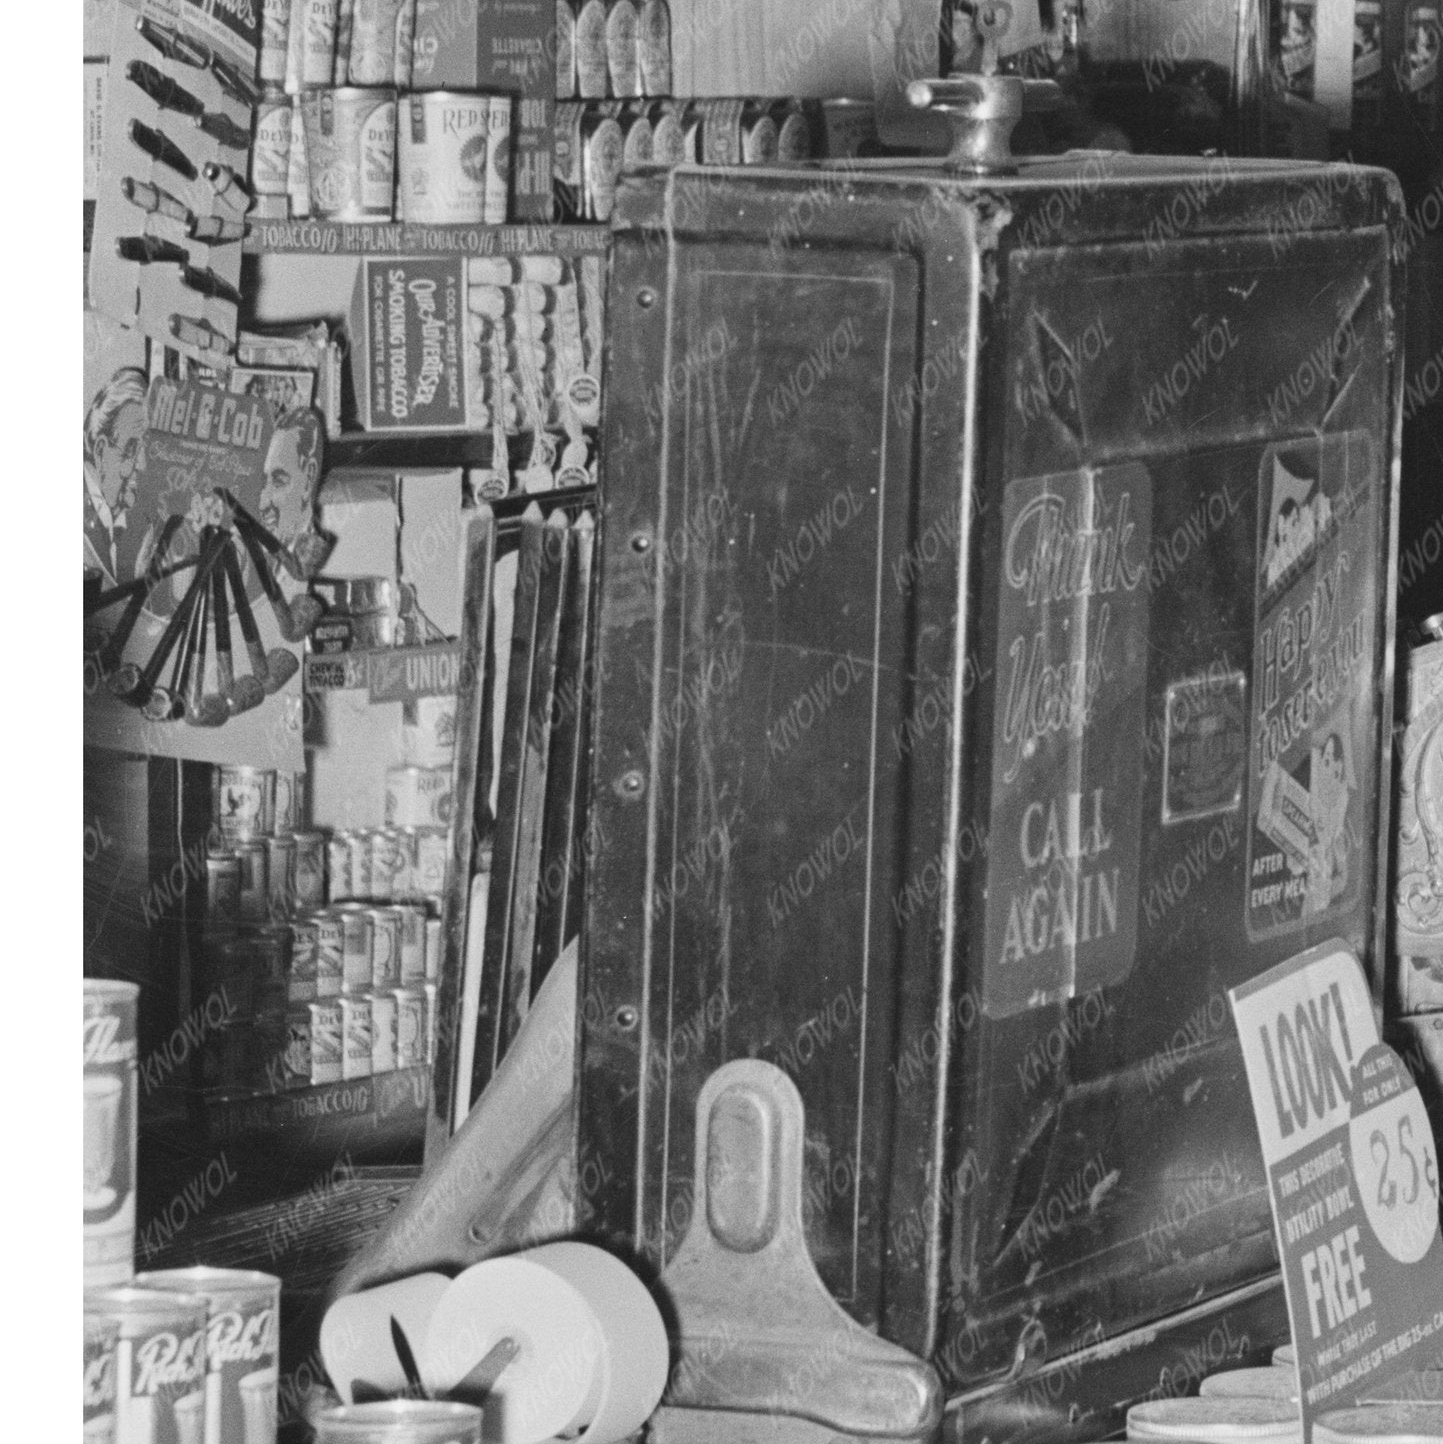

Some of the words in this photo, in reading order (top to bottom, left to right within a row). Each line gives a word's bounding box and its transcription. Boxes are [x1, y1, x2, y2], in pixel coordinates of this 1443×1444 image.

[261, 224, 321, 248] TOBACCO
[342, 228, 401, 252] HI-PLANE
[421, 229, 478, 251] TOBACCO
[499, 228, 553, 252] HI-PLANE
[388, 269, 406, 345] SMOKING
[446, 287, 456, 316] COOL
[373, 300, 385, 363] CIGARETTE
[447, 323, 458, 365] SWEET
[390, 345, 409, 418] TOBACCO
[412, 316, 446, 408] ADVERTISER
[447, 367, 460, 408] SMOKE
[1259, 549, 1350, 718] Happy
[405, 652, 459, 691] UNION
[1020, 788, 1113, 868] CALL
[1252, 852, 1285, 878] AFTER
[1000, 866, 1120, 963] AGAIN
[1251, 882, 1283, 908] EVERY
[1258, 981, 1354, 1140] LOOK!
[1361, 1062, 1377, 1079] ALL
[1362, 1088, 1378, 1105] FOR
[1380, 1076, 1401, 1098] ONLY
[1278, 1169, 1300, 1198] THIS
[1369, 1114, 1438, 1210] 25¢
[1285, 1200, 1325, 1244] UTILITY
[1325, 1185, 1355, 1222] BOWL
[1301, 1224, 1372, 1339] FREE
[1358, 1320, 1377, 1347] LAST
[1307, 1379, 1331, 1406] WITH
[1330, 1353, 1371, 1394] PURCHASE
[1370, 1347, 1383, 1368] OF
